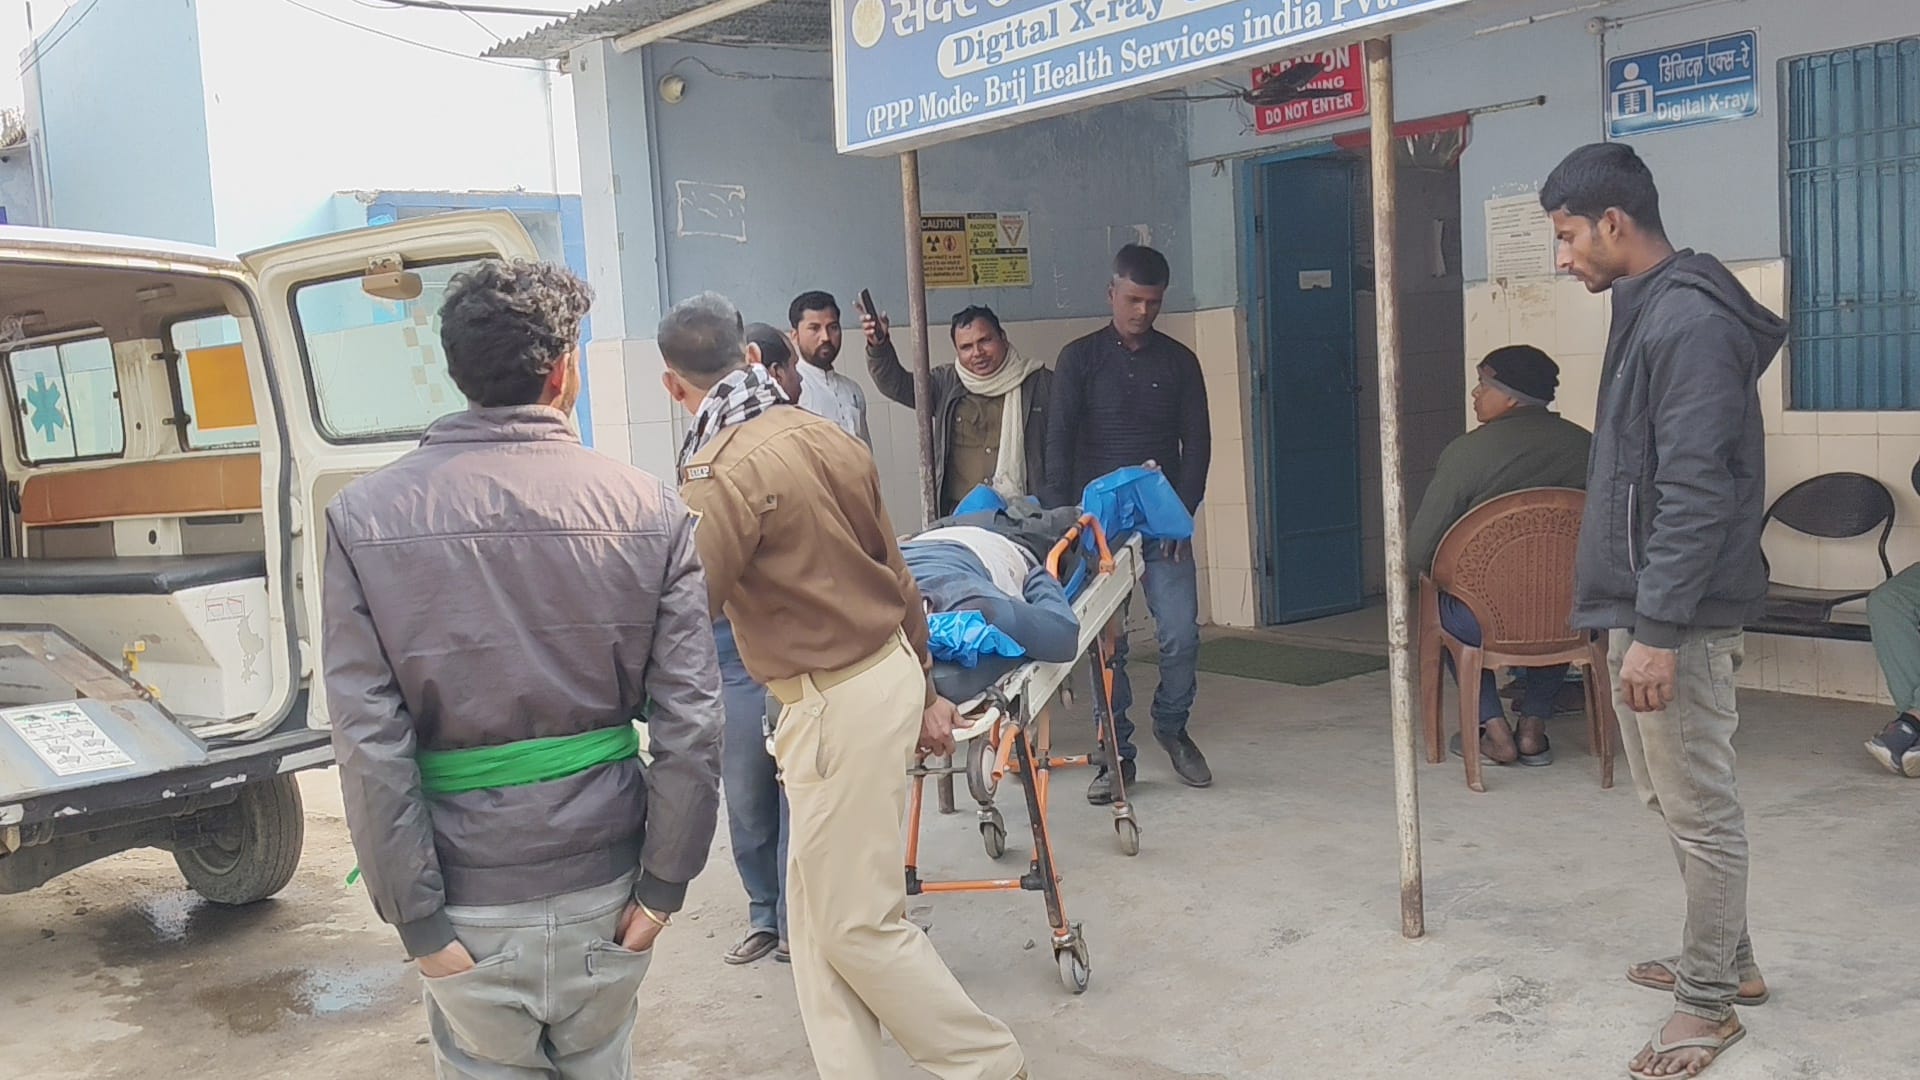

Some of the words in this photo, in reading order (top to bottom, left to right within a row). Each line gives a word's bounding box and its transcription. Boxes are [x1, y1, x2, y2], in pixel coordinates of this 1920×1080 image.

[953, 9, 1059, 66] Digital
[1070, 0, 1161, 33] X-ray
[866, 98, 914, 137] (PPP
[918, 86, 979, 124] Mode-
[984, 67, 1026, 108] Brij
[1032, 45, 1113, 96] Health
[1120, 24, 1235, 73] Services
[1242, 1, 1323, 45] india
[1265, 108, 1282, 126] DO
[1285, 101, 1309, 121] NOT
[1312, 92, 1353, 115] ENTER
[1657, 96, 1704, 121] Digital
[1708, 92, 1749, 112] X-ray
[921, 218, 960, 230] CAUTION
